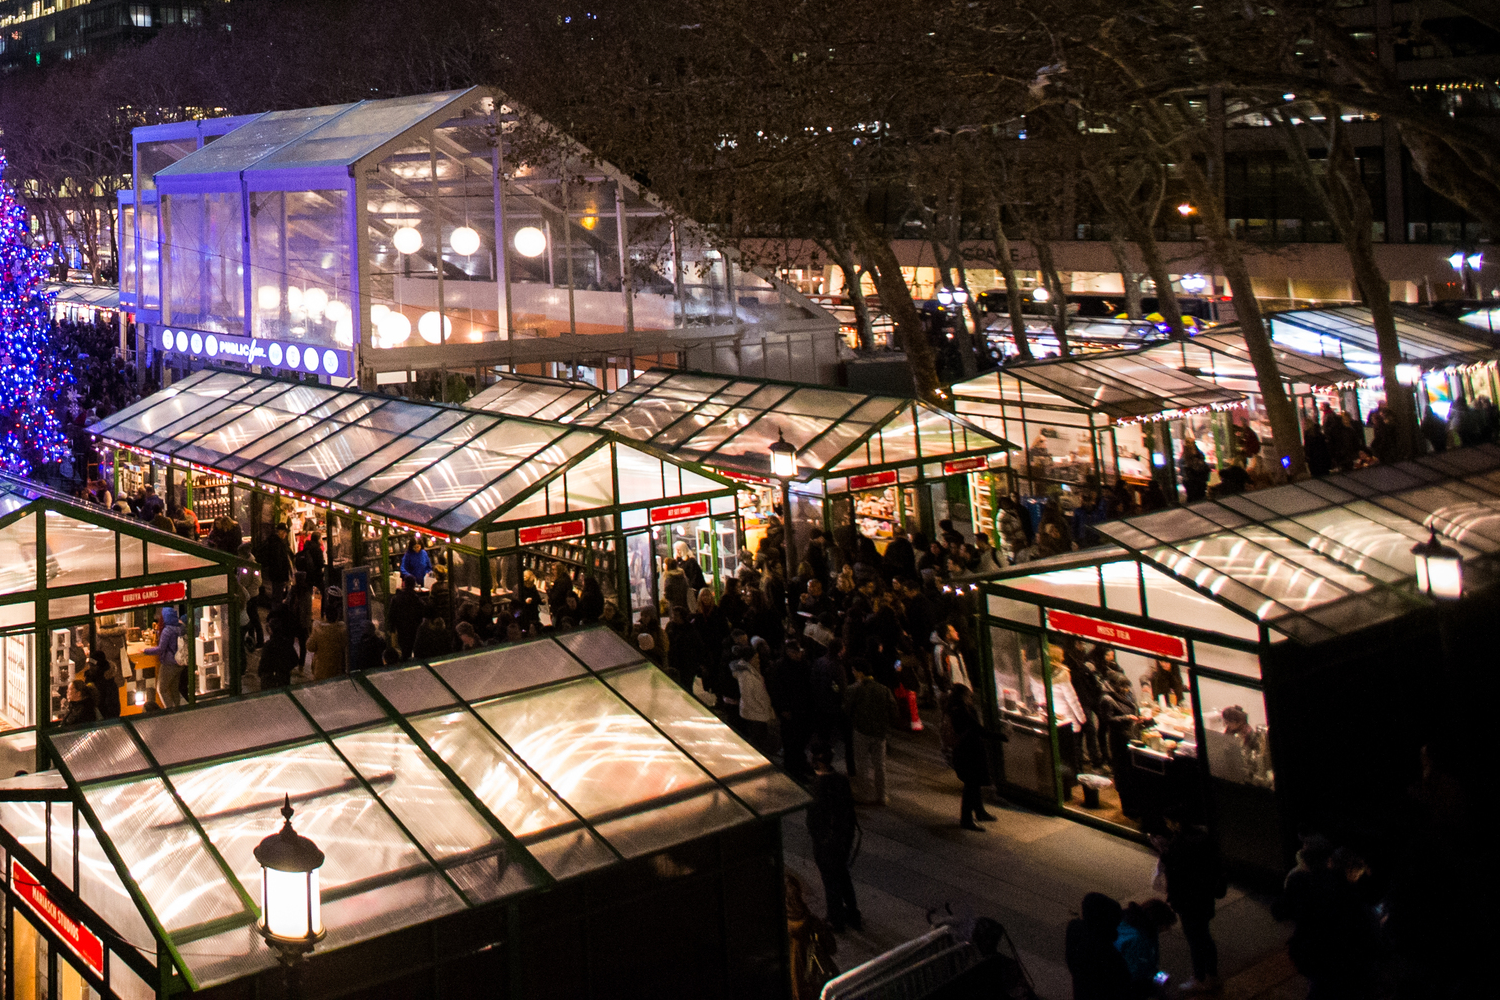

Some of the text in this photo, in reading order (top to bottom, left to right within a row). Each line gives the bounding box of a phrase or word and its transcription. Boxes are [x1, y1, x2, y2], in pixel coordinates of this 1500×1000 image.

[219, 340, 249, 356] PUBLIC
[142, 590, 159, 599] GAMES
[1116, 629, 1131, 641] TEA
